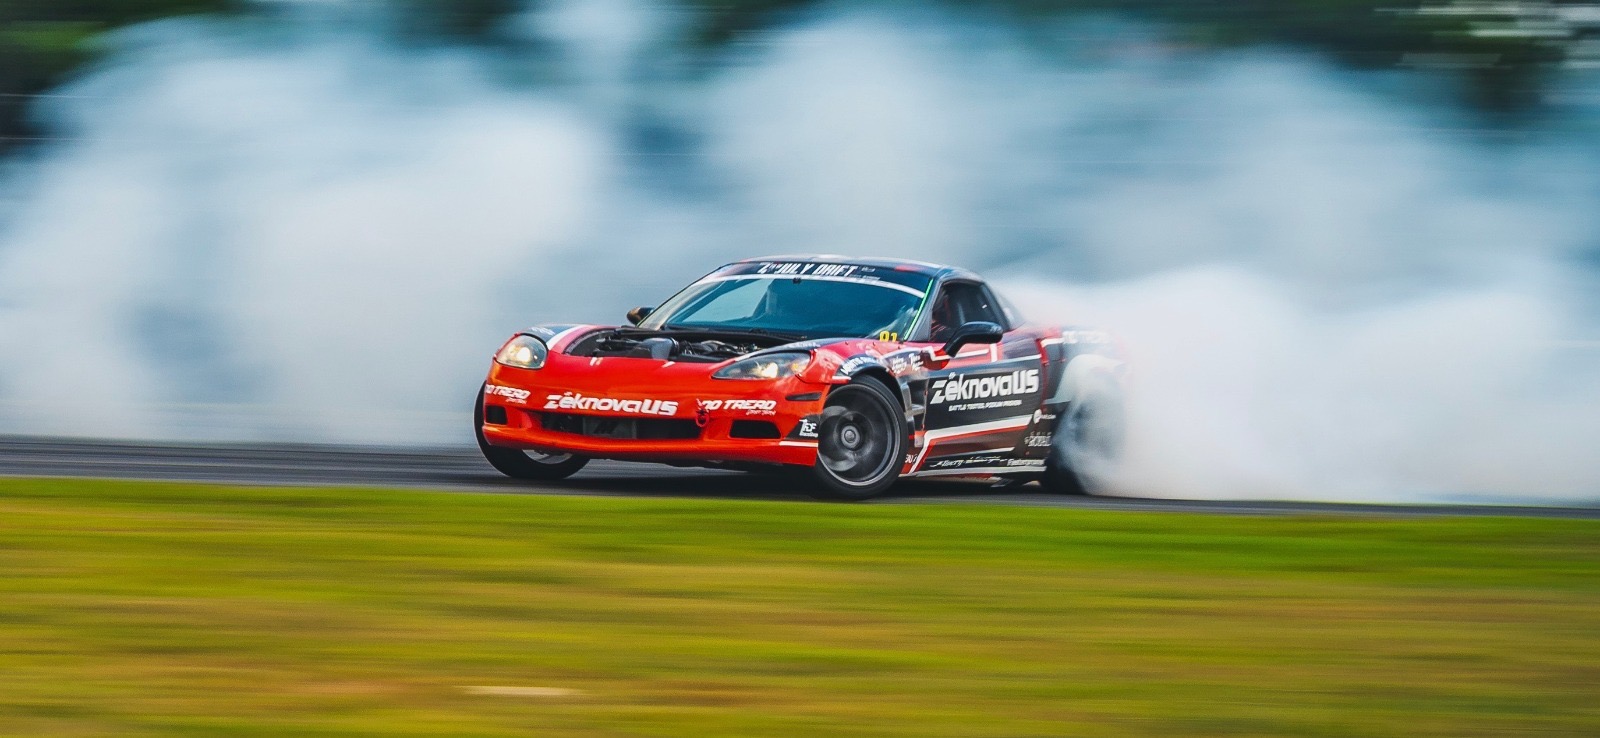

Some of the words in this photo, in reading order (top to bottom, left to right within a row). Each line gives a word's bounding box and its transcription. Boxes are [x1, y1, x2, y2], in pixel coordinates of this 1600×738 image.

[774, 262, 814, 275] JULY
[812, 263, 858, 277] DRIFT
[723, 399, 777, 411] TREAD
